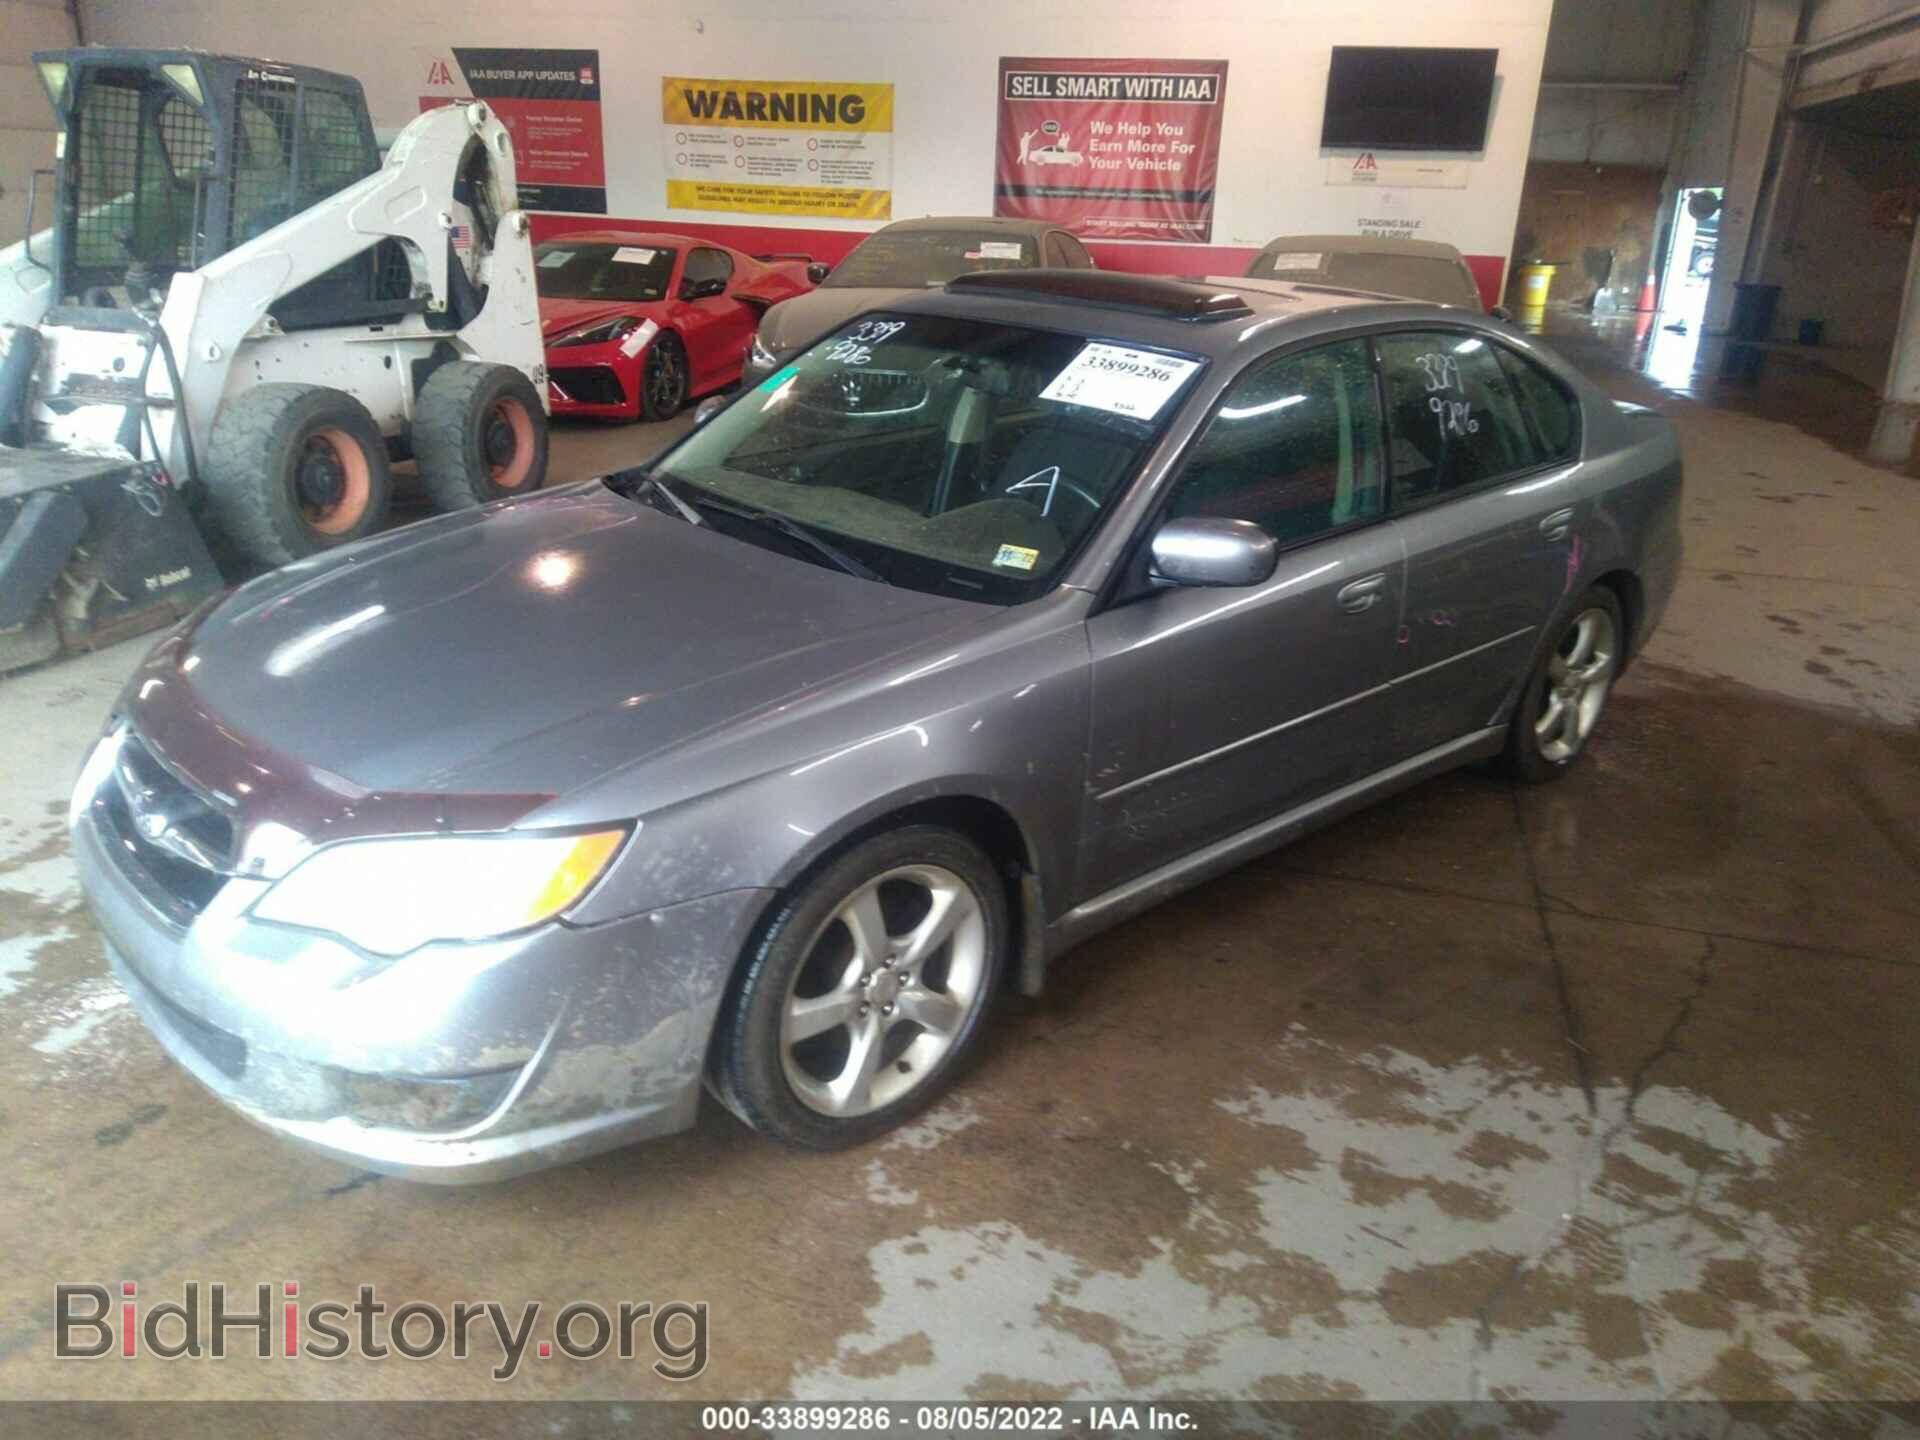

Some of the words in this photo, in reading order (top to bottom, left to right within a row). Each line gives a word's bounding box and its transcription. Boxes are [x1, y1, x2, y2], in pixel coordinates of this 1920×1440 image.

[470, 69, 486, 79] IAA
[487, 69, 514, 79] BUYER
[517, 70, 534, 80] APP
[535, 70, 575, 81] UPDATES
[1011, 76, 1051, 96] SELL
[1056, 76, 1121, 98] SMART
[1125, 77, 1174, 99] WITH
[1178, 78, 1211, 99] IAA
[683, 89, 865, 124] WARNING
[1090, 121, 1114, 135] We
[1118, 121, 1150, 137] Help
[1156, 122, 1184, 137] You
[1089, 141, 1123, 153] Earn
[1128, 141, 1166, 154] More
[1171, 142, 1196, 154] For
[1089, 158, 1122, 170] Your
[1125, 158, 1181, 171] Vehicle
[1400, 220, 1421, 229] SALE
[1082, 356, 1171, 382] 33899286
